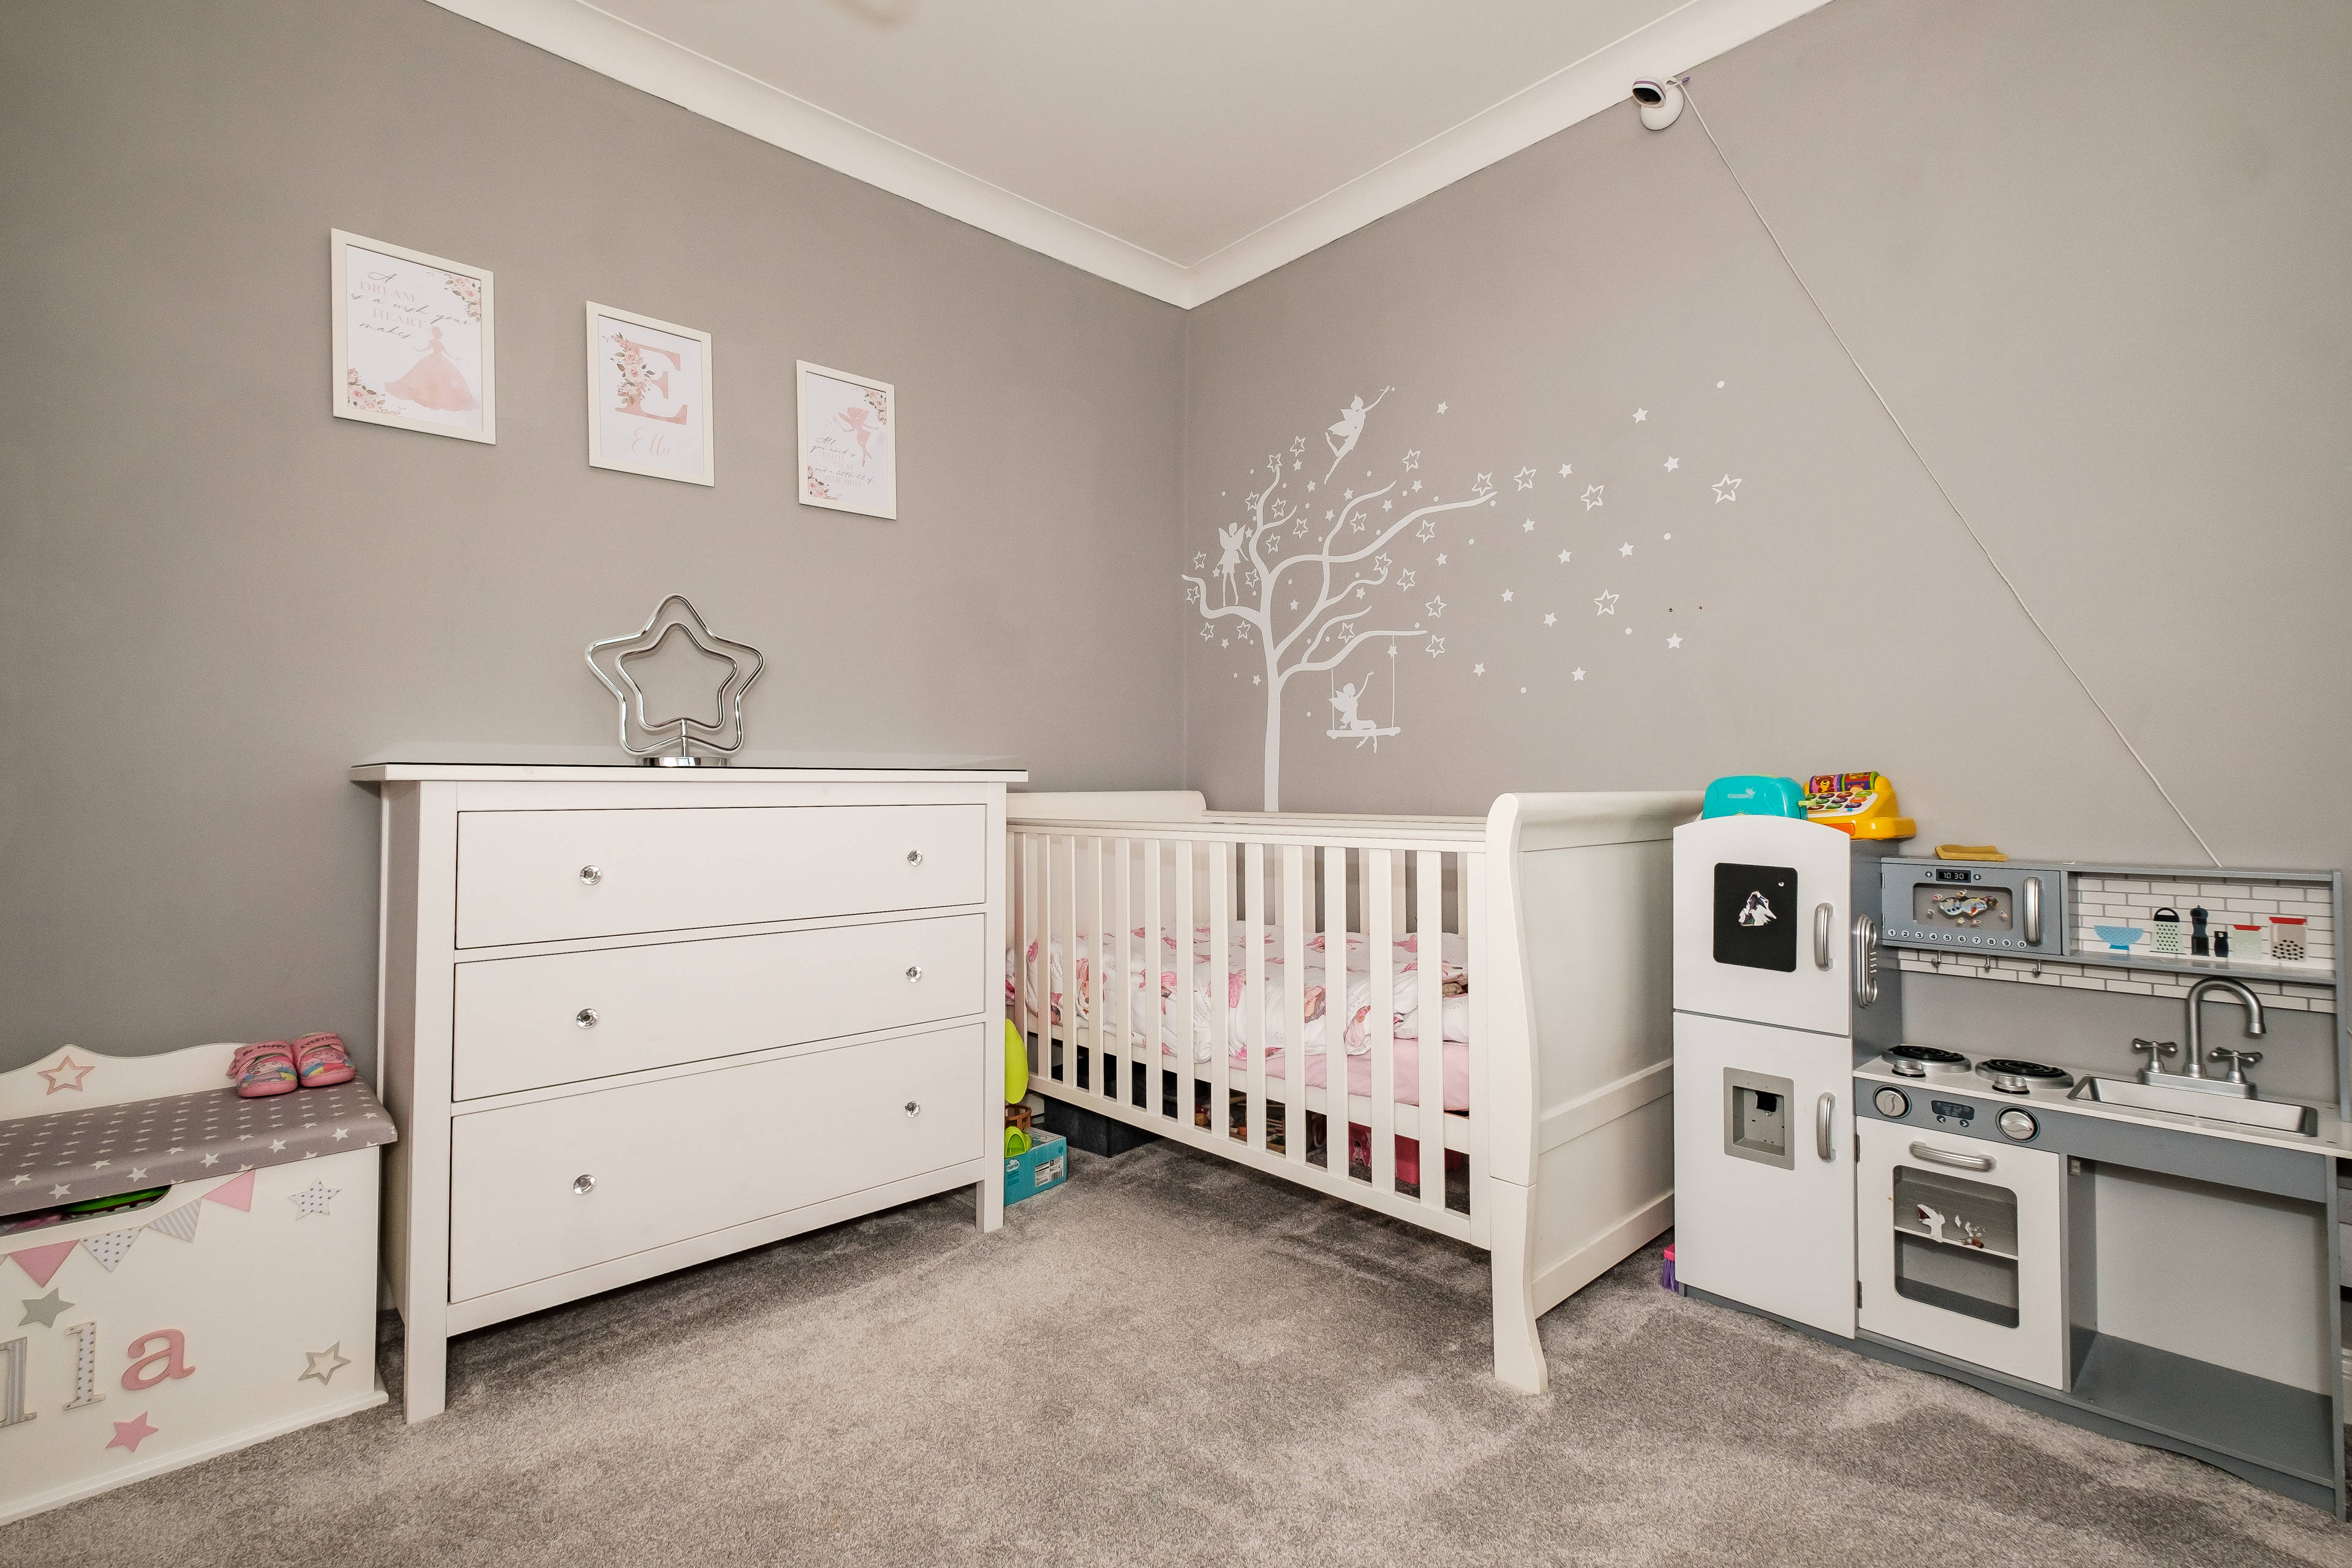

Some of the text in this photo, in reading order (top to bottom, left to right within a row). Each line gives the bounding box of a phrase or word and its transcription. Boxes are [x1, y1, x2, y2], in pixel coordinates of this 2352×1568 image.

[360, 281, 415, 303] DREAM
[373, 309, 426, 328] HEART
[393, 303, 429, 314] wish
[430, 314, 472, 325] your
[359, 323, 413, 339] makes
[616, 341, 687, 425] E
